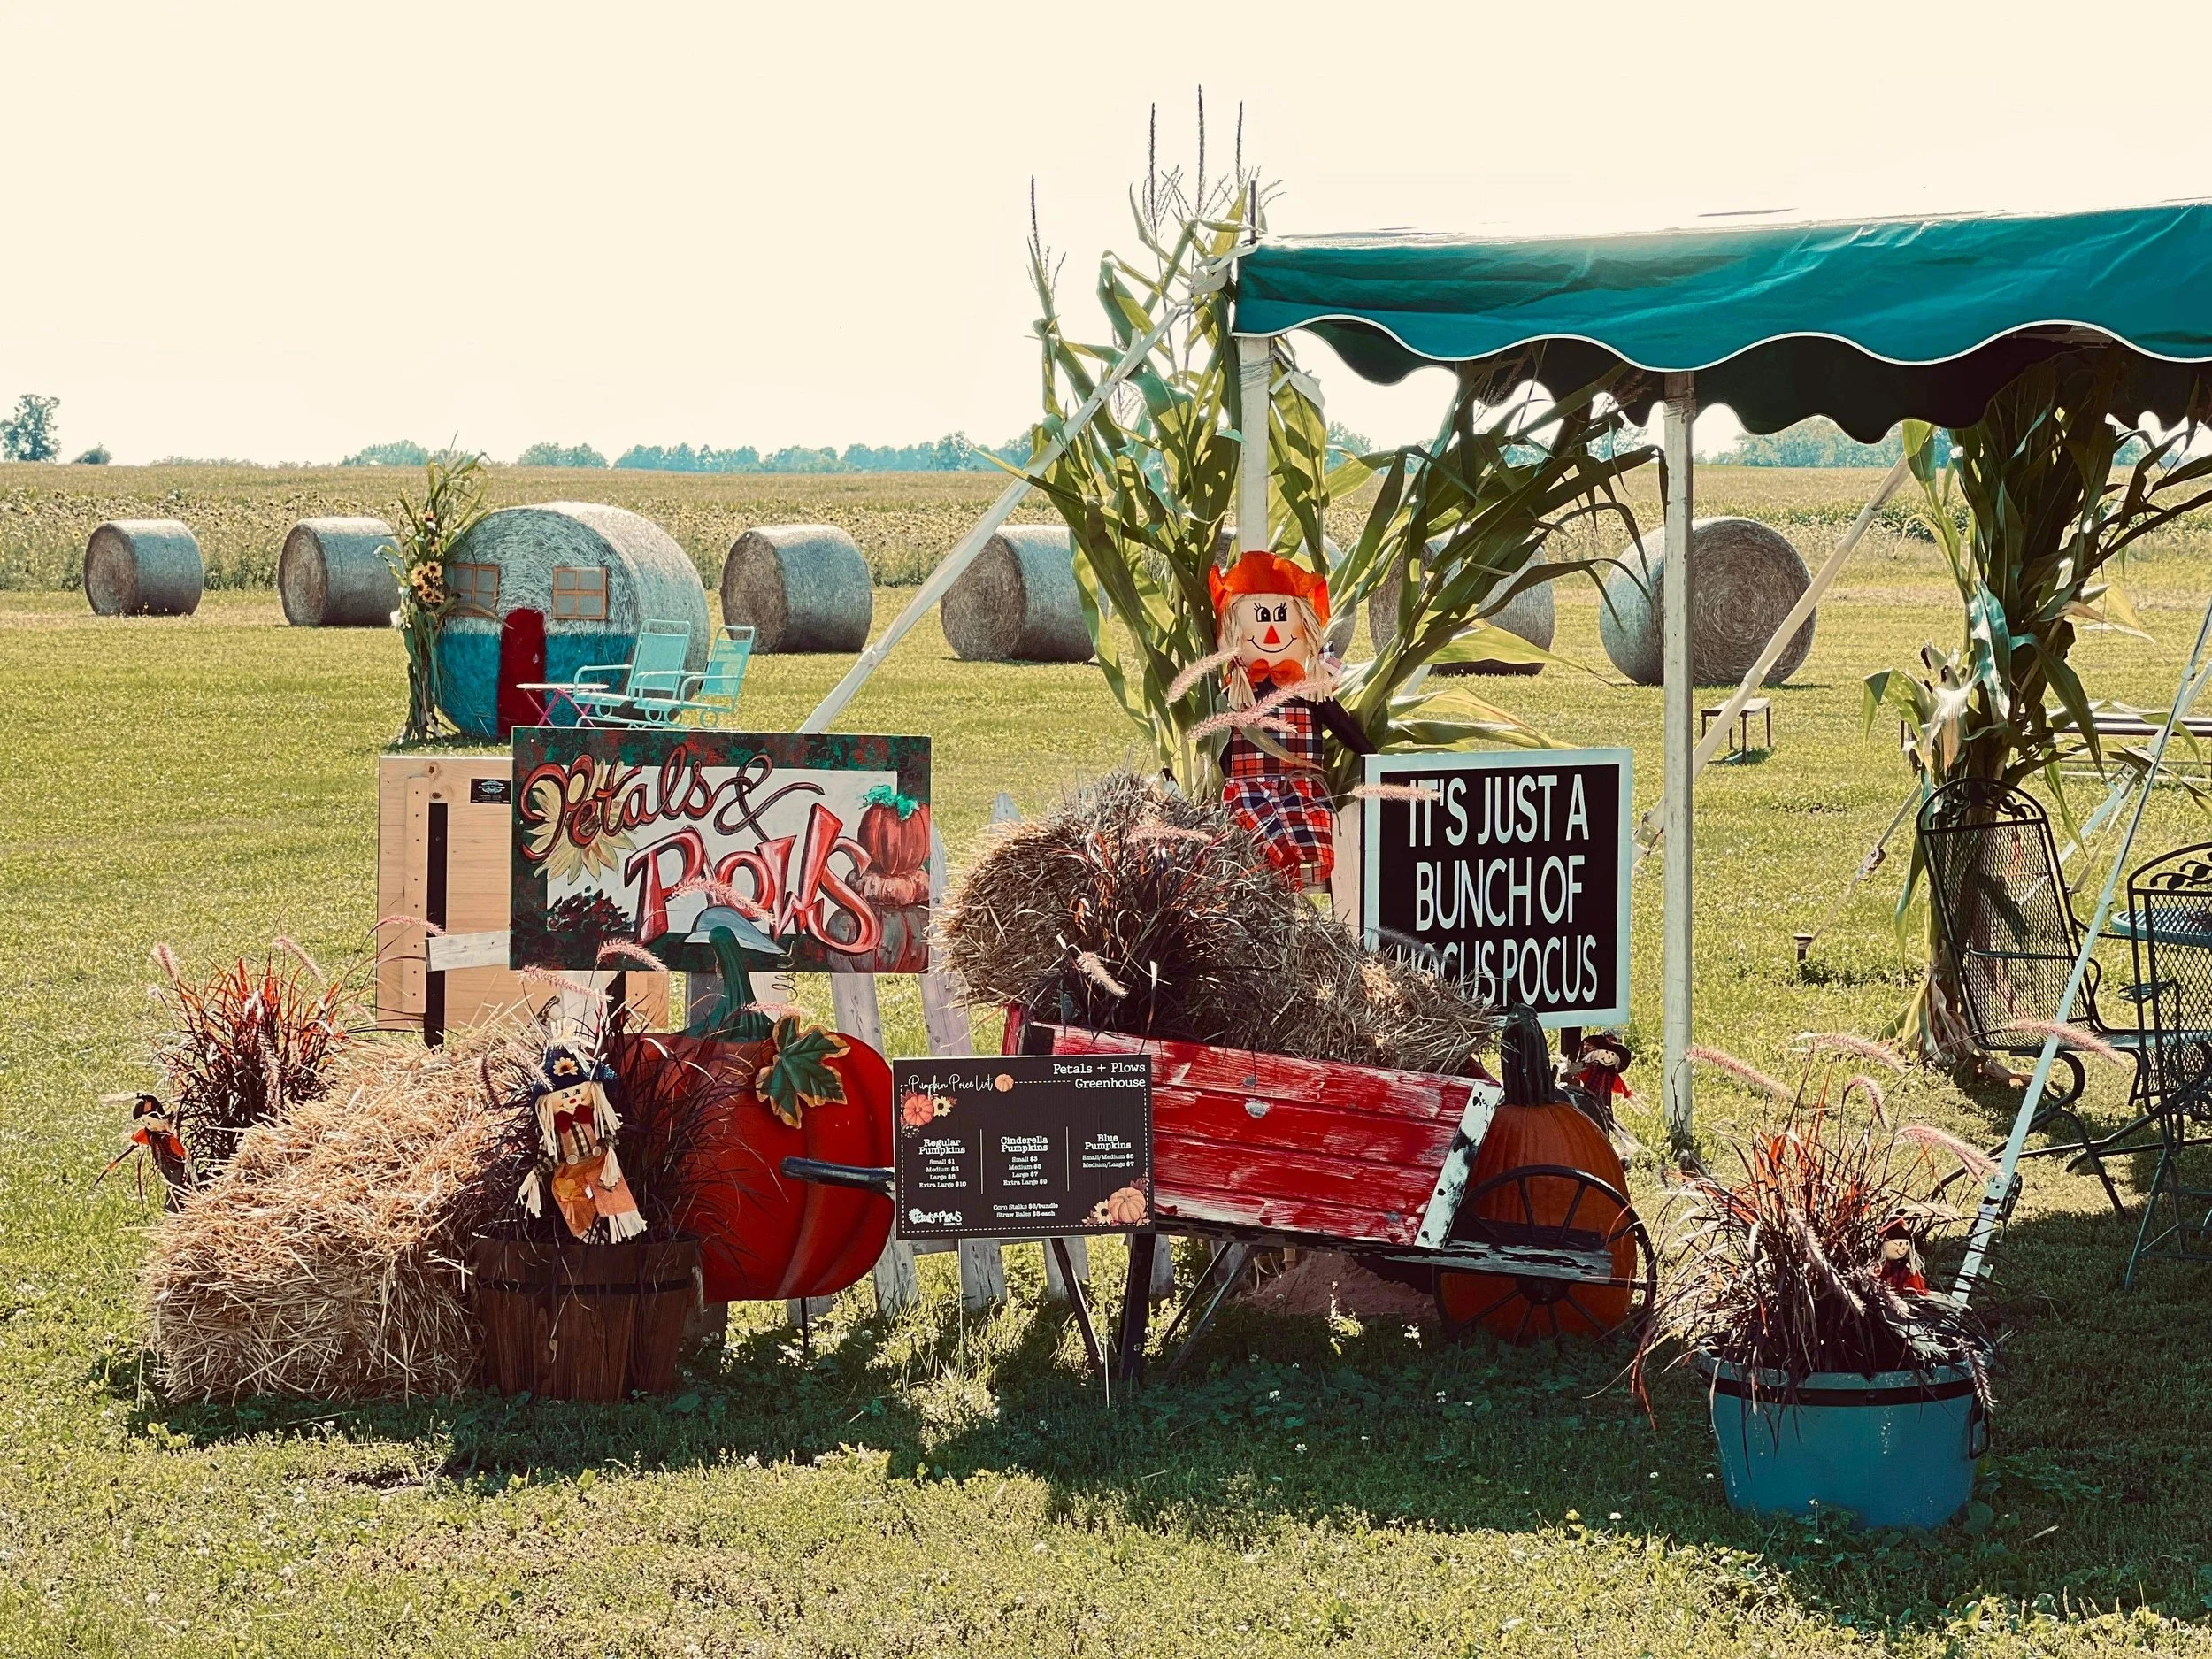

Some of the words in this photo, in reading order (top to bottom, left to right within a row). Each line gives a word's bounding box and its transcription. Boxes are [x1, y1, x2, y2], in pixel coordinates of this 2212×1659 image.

[520, 743, 715, 862] Petals
[713, 753, 826, 842] &
[1409, 777, 1468, 847] IT'S
[1478, 774, 1558, 845] JUST
[1565, 773, 1589, 841] A
[1416, 856, 1532, 932] BUNCH
[1540, 855, 1586, 925] OF
[1502, 934, 1597, 1007] POCUS
[1053, 1064, 1094, 1075] Petals
[1097, 1064, 1107, 1074] +
[1110, 1062, 1146, 1073] Plows
[908, 1074, 949, 1100] Pumpkin
[949, 1073, 974, 1092] Price
[975, 1073, 994, 1092] List
[1074, 1077, 1146, 1089] Greenhouse
[923, 1138, 961, 1148] Regular
[1000, 1136, 1048, 1144] Cinderella
[918, 1146, 965, 1156] Pumpkins
[1001, 1144, 1048, 1153] Pumpkins
[1084, 1142, 1131, 1151] Pumpkins
